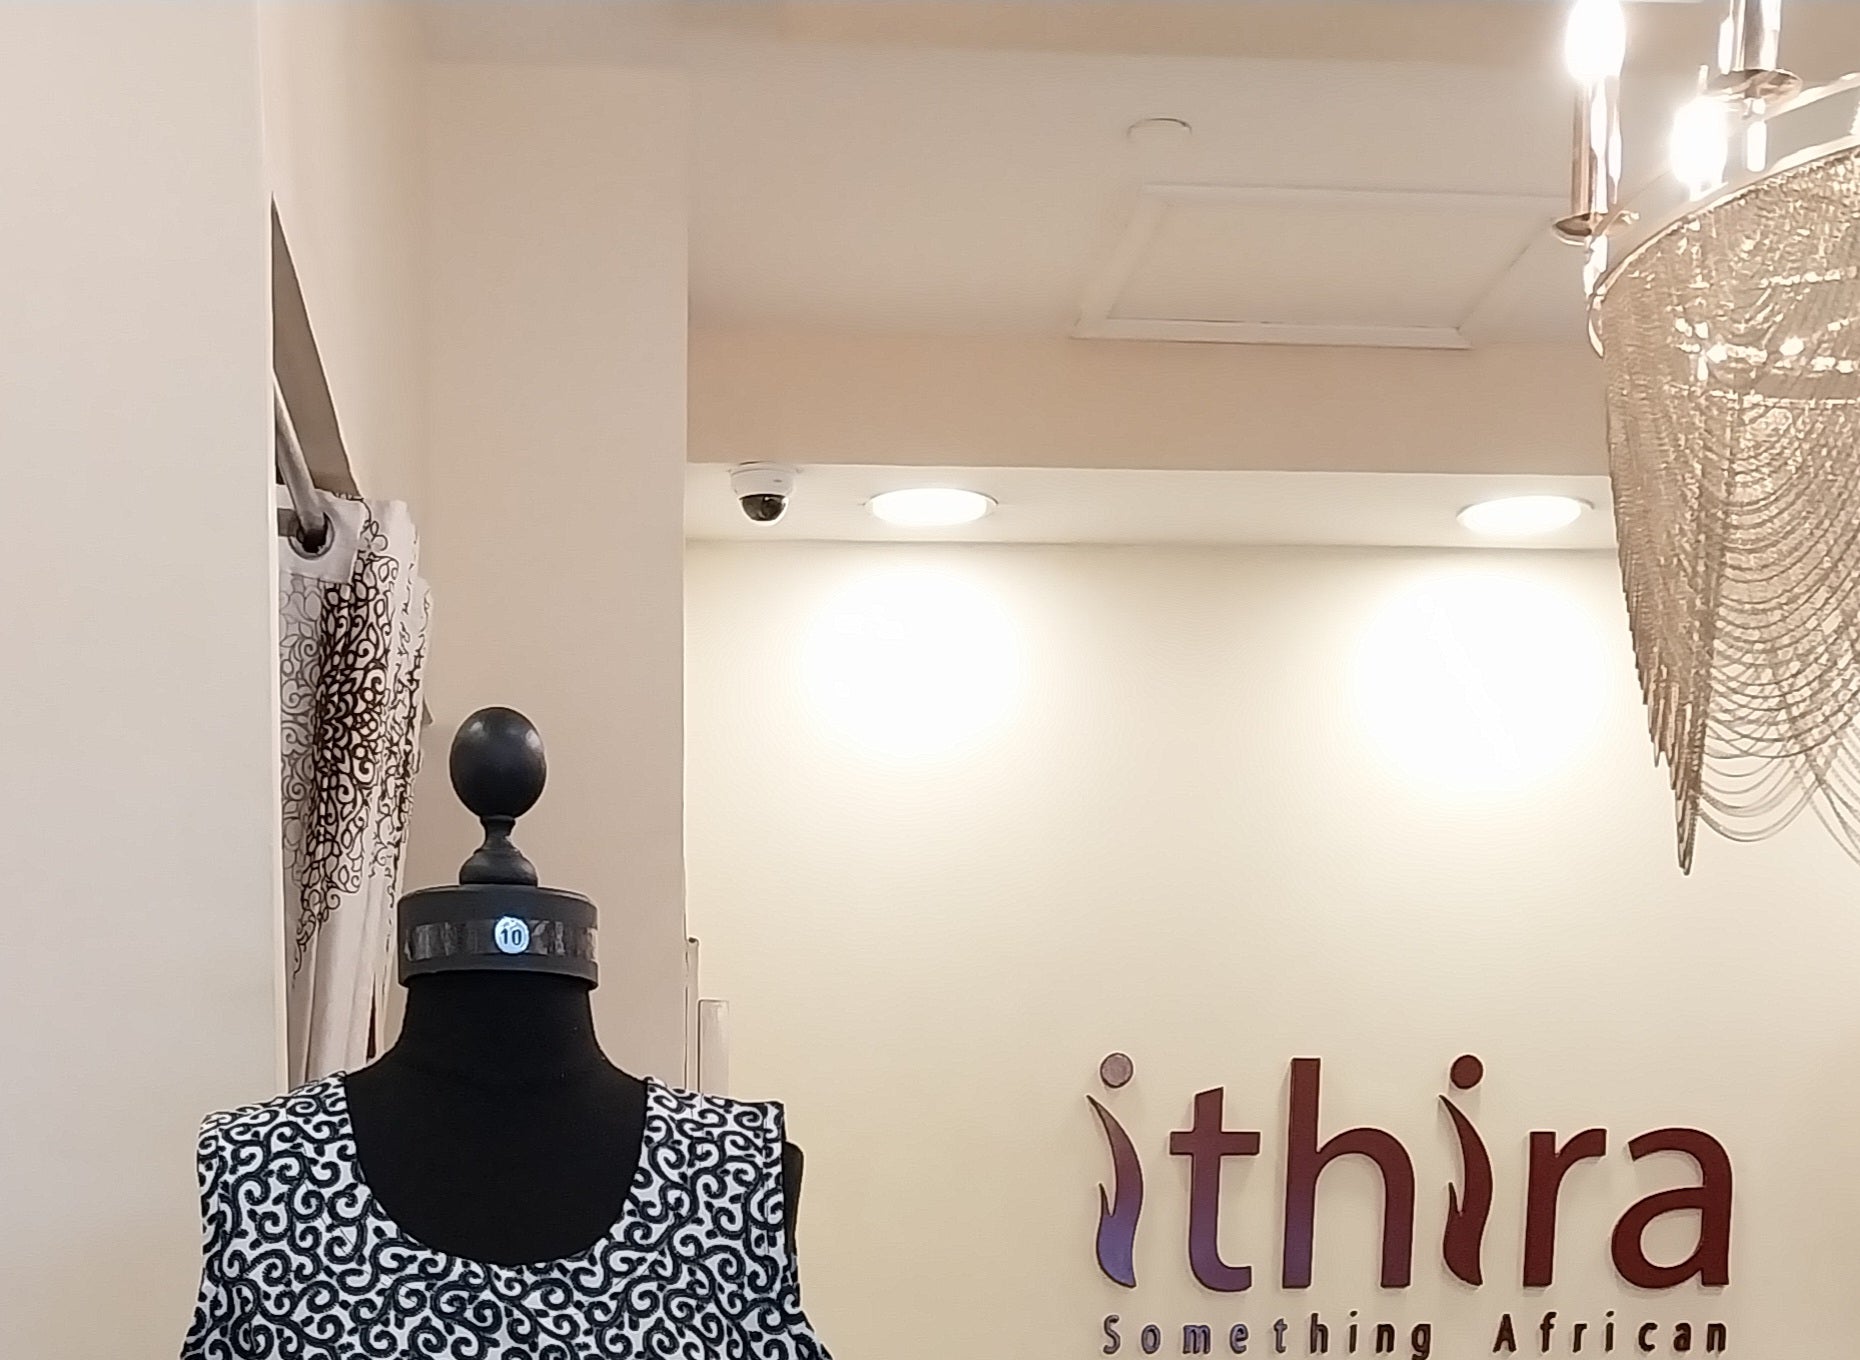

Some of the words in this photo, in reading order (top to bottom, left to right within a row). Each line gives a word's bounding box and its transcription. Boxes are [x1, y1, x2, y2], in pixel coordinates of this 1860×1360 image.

[501, 928, 522, 946] 10
[1086, 1052, 1733, 1291] ithira
[1493, 1310, 1728, 1355] African
